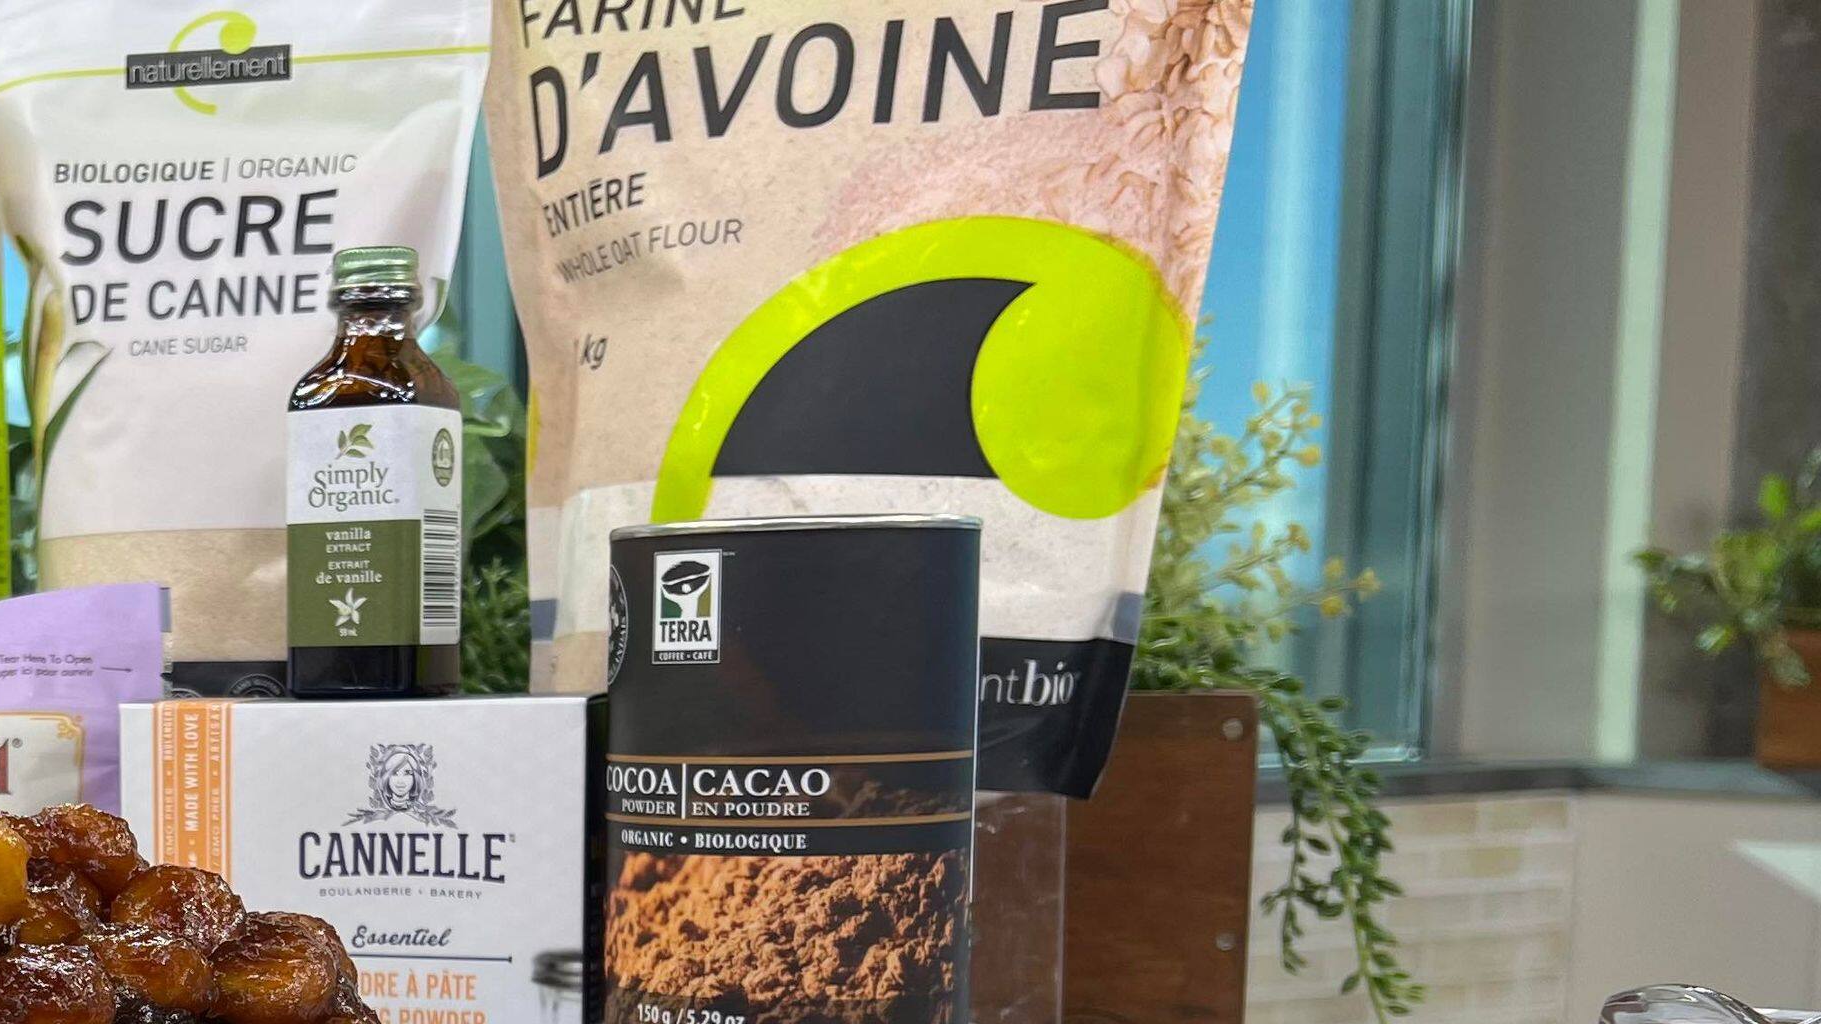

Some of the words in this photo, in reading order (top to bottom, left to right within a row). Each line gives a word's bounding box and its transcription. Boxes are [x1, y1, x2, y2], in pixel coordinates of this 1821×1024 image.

[130, 53, 287, 84] naturellement
[530, 0, 1109, 179] D'AVOINE
[54, 161, 216, 184] BIOLOGIQUE
[238, 154, 358, 179] ORGANIC
[542, 172, 647, 238] ENTIÈRE
[61, 188, 339, 267] SUCRE
[557, 246, 612, 284] WHOLE
[611, 231, 642, 265] OAT
[649, 219, 742, 253] FLOUR
[72, 282, 128, 325] DE
[149, 273, 320, 321] CANNE
[128, 337, 180, 357] CANE
[183, 335, 248, 356] SUGAR
[581, 334, 609, 370] kg
[313, 461, 390, 490] Simply
[325, 526, 372, 541] vanilla
[326, 543, 371, 553] EXTRACT
[315, 571, 333, 585] de
[336, 570, 383, 585] vanille
[328, 560, 370, 570] EXTRAIT
[660, 620, 712, 643] TERRA
[658, 651, 685, 661] COFFEE
[184, 713, 200, 749] LOVE
[184, 753, 200, 789] WITH
[606, 765, 679, 796] COCOA
[693, 768, 832, 797] CACAO
[184, 792, 200, 832] MADE
[621, 799, 677, 816] POWDER
[692, 801, 721, 818] EN
[724, 800, 811, 818] POUDRE
[621, 831, 674, 849] ORGANIC
[694, 832, 808, 851] BIOLOGIQUE
[299, 831, 506, 884] CANNELLE
[319, 887, 413, 898] BOULANGERIE
[430, 888, 483, 901] BAKERY
[351, 924, 453, 949] Essentiel
[426, 968, 477, 1001] PÂTE
[636, 1003, 661, 1023] 150
